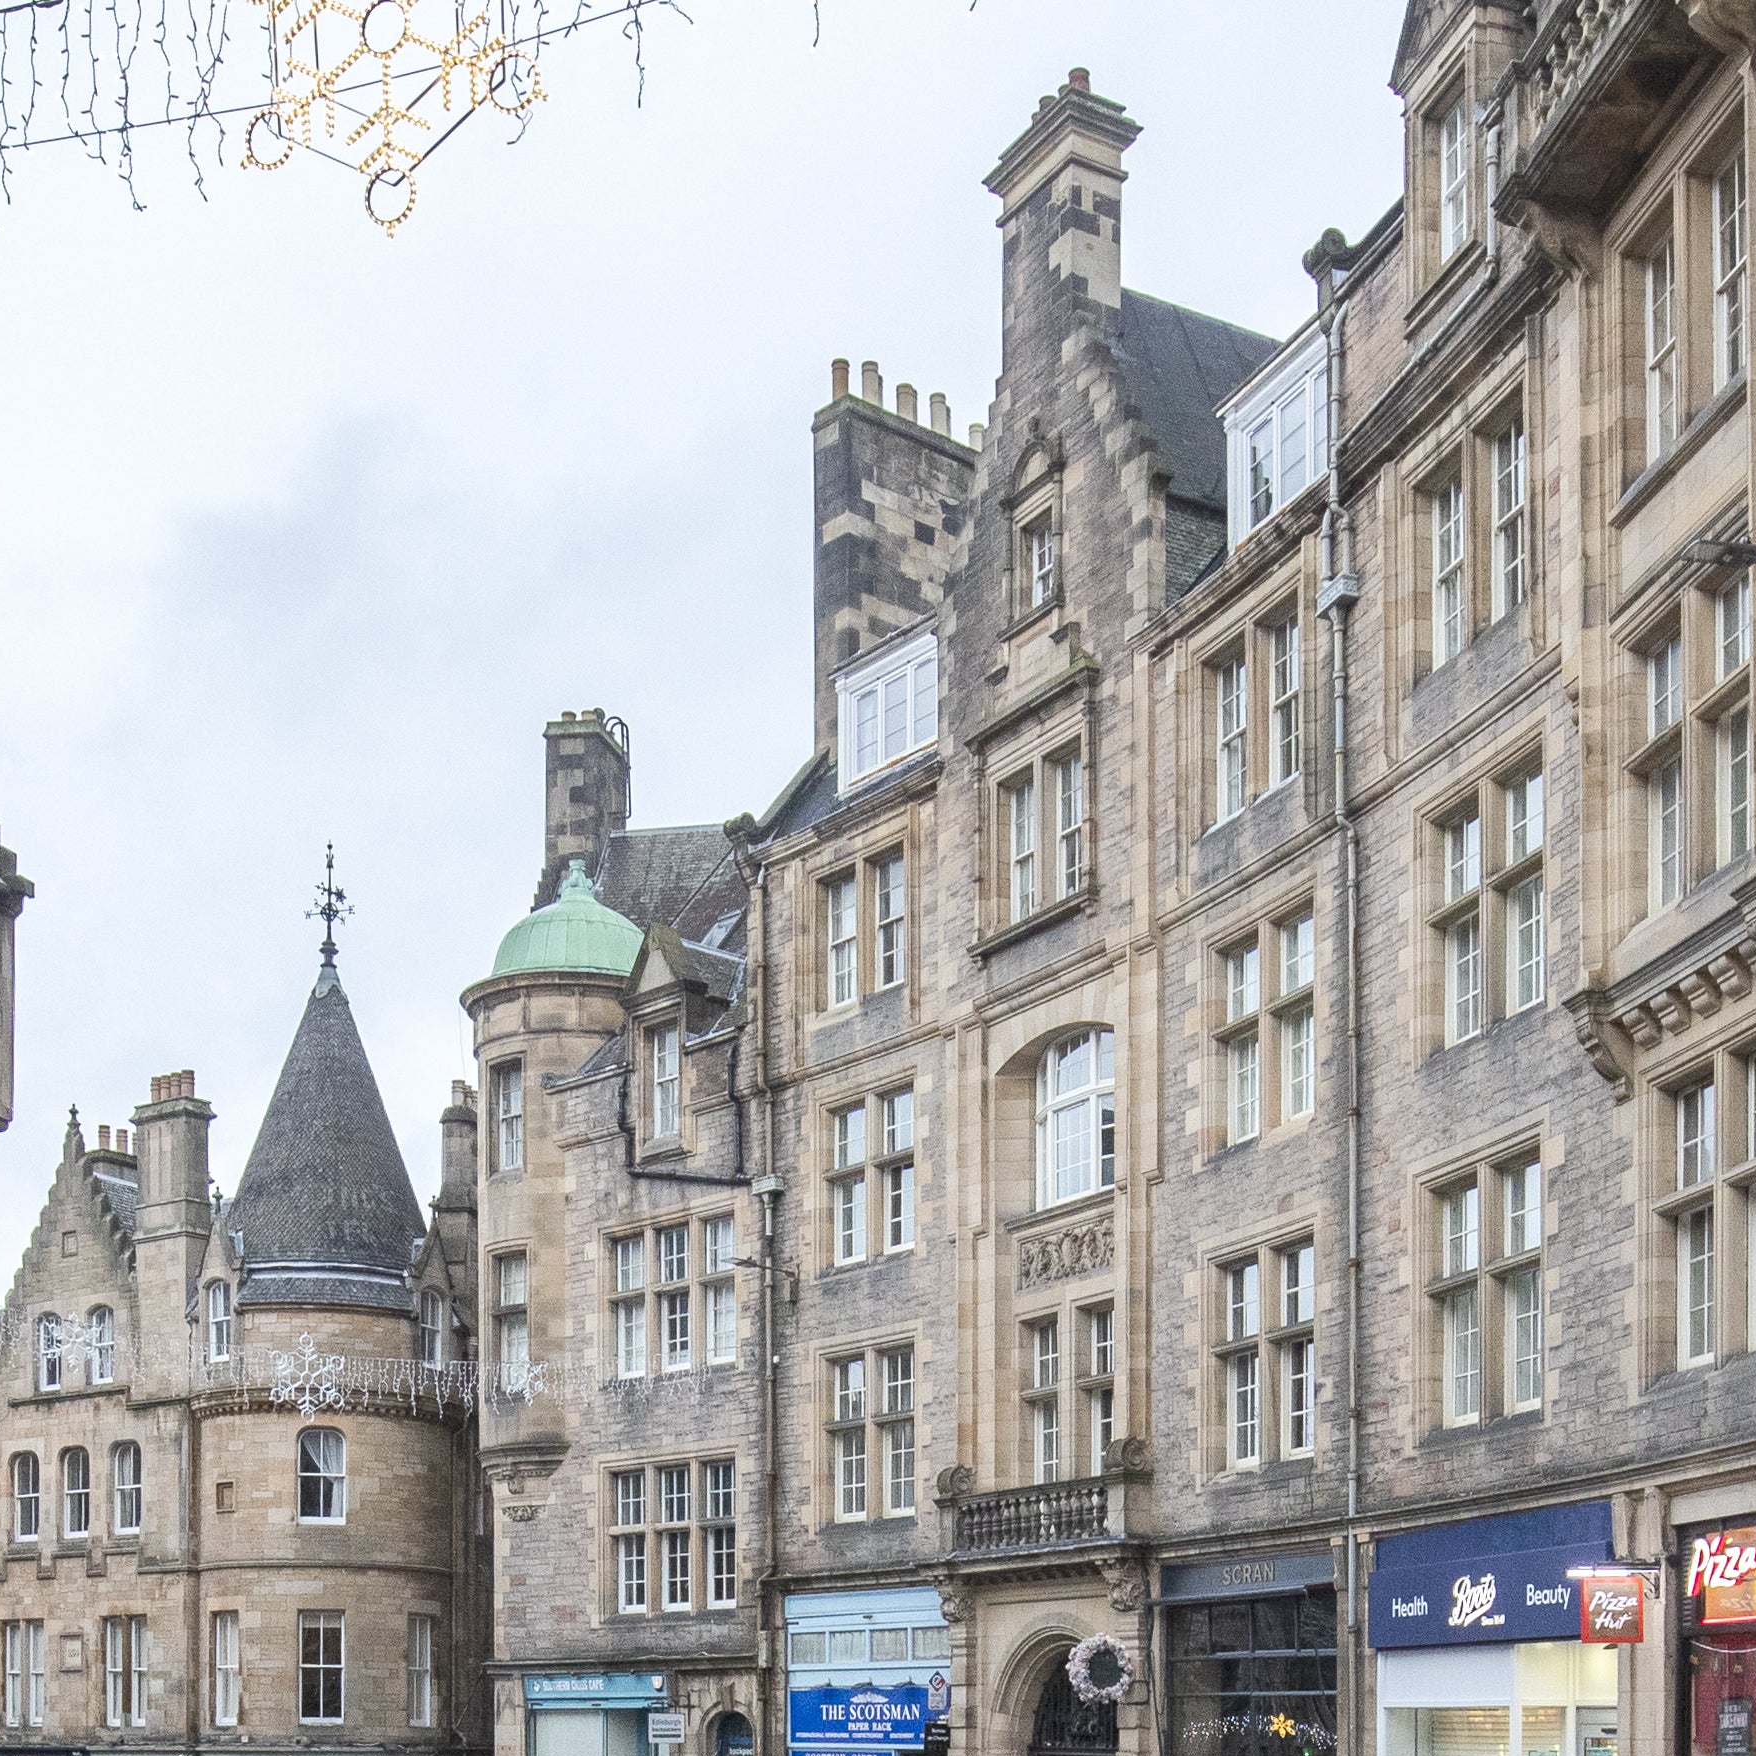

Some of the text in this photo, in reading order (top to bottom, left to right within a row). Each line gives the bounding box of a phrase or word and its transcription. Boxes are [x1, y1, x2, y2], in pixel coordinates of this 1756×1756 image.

[1222, 1561, 1275, 1585] SCRAN
[1391, 1583, 1572, 1618] Health Beauty
[1448, 1572, 1497, 1627] Boots
[1589, 1590, 1638, 1612] Pizza
[1594, 1611, 1633, 1631] Hut
[820, 1703, 921, 1721] THE SCOTSMAN
[847, 1722, 870, 1732] PAPER
